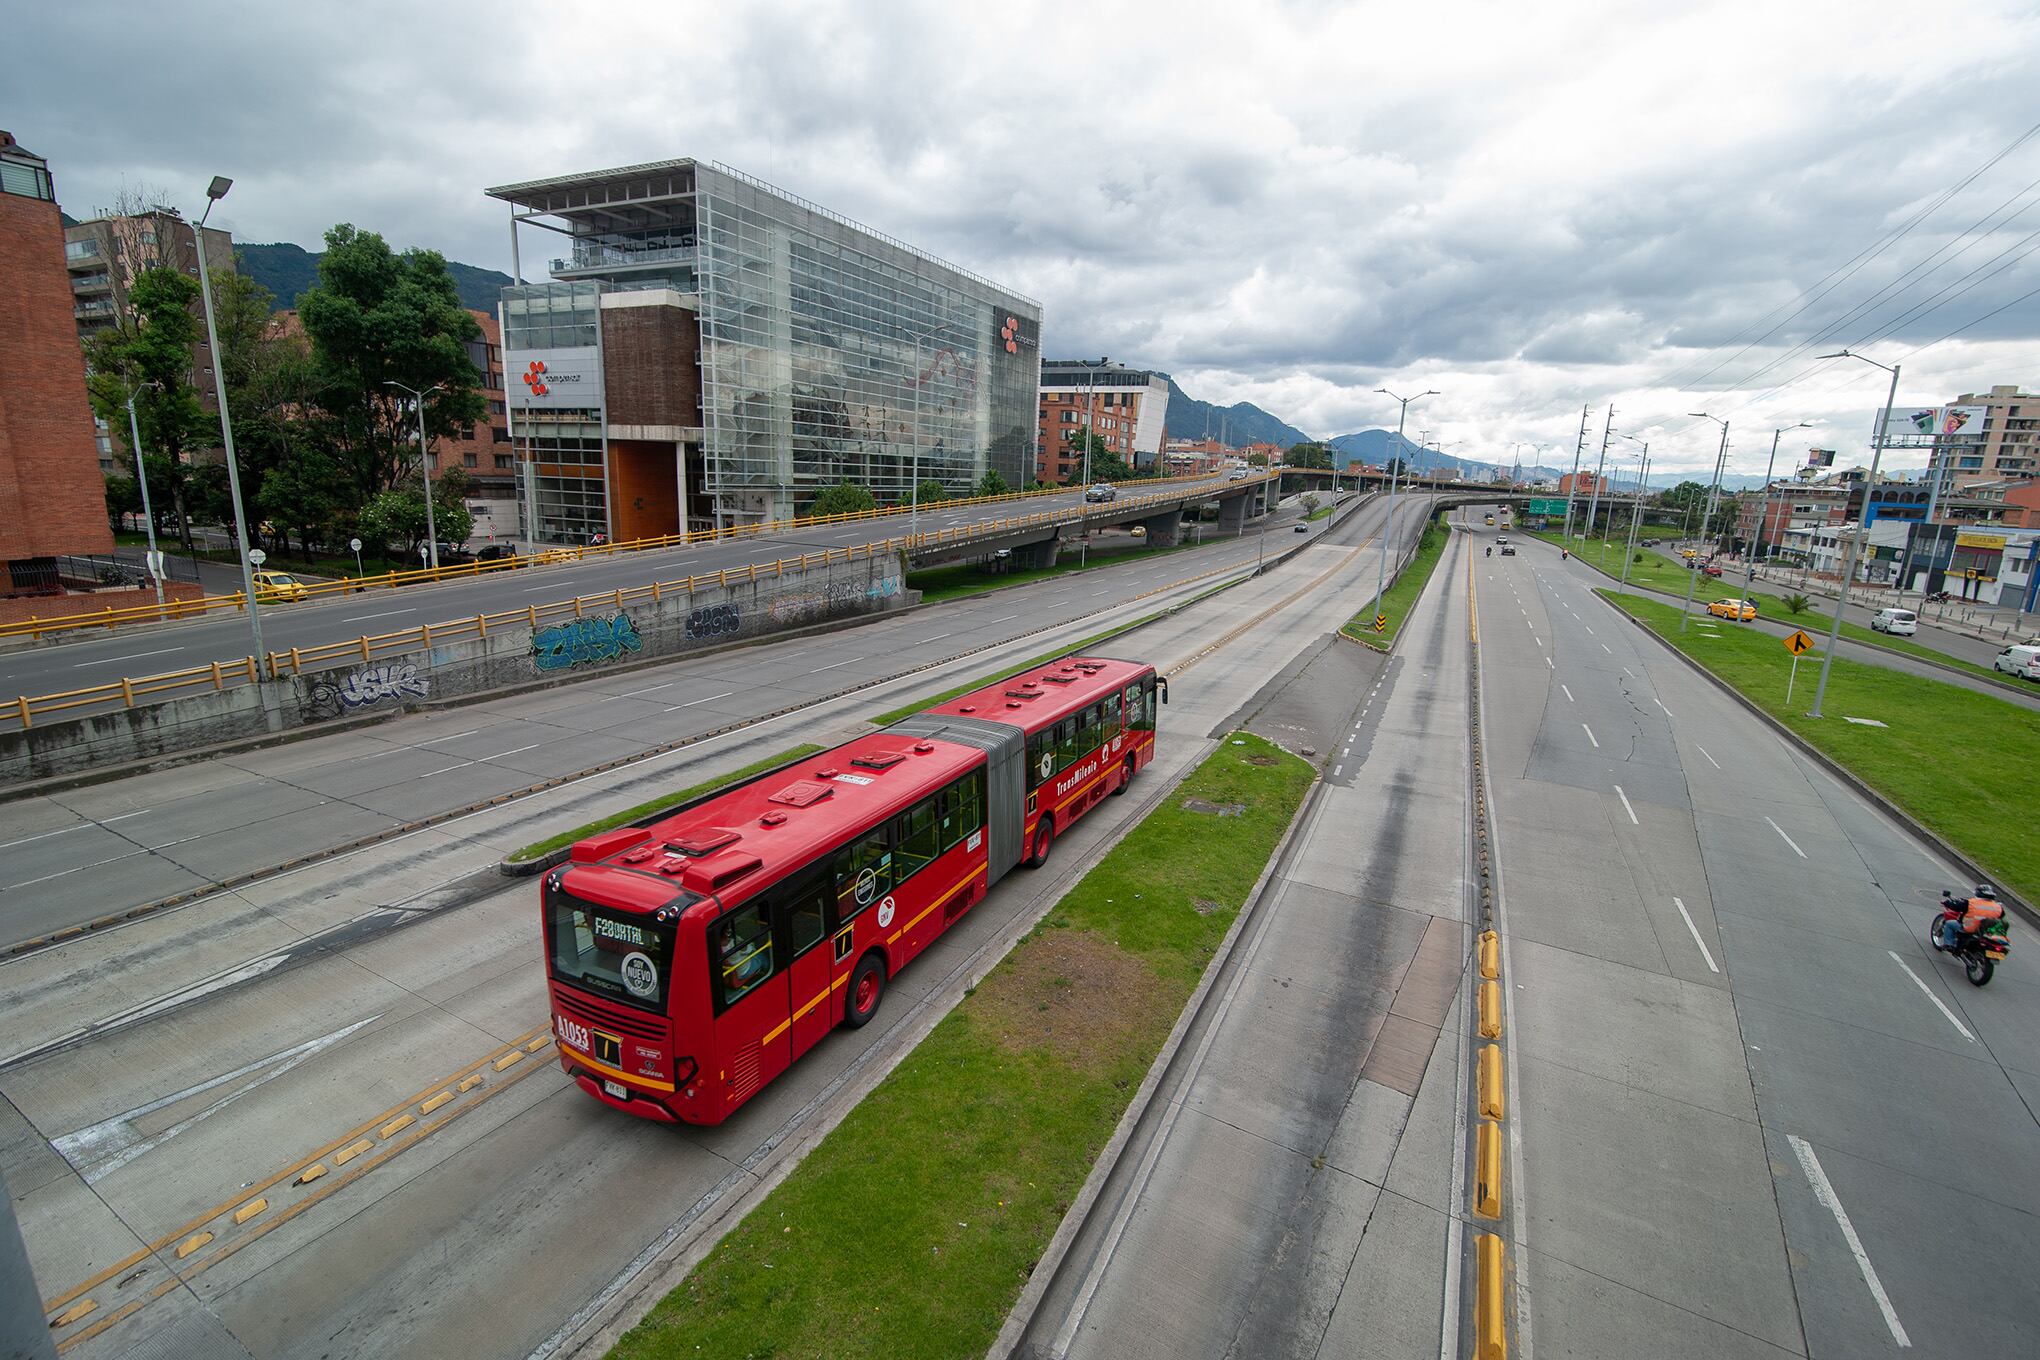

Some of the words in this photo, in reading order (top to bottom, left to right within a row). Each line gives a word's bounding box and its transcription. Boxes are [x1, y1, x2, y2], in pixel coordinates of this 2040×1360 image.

[1057, 760, 1097, 796] TransMilenio
[627, 966, 651, 982] NUEVO
[558, 1015, 589, 1050] A1053
